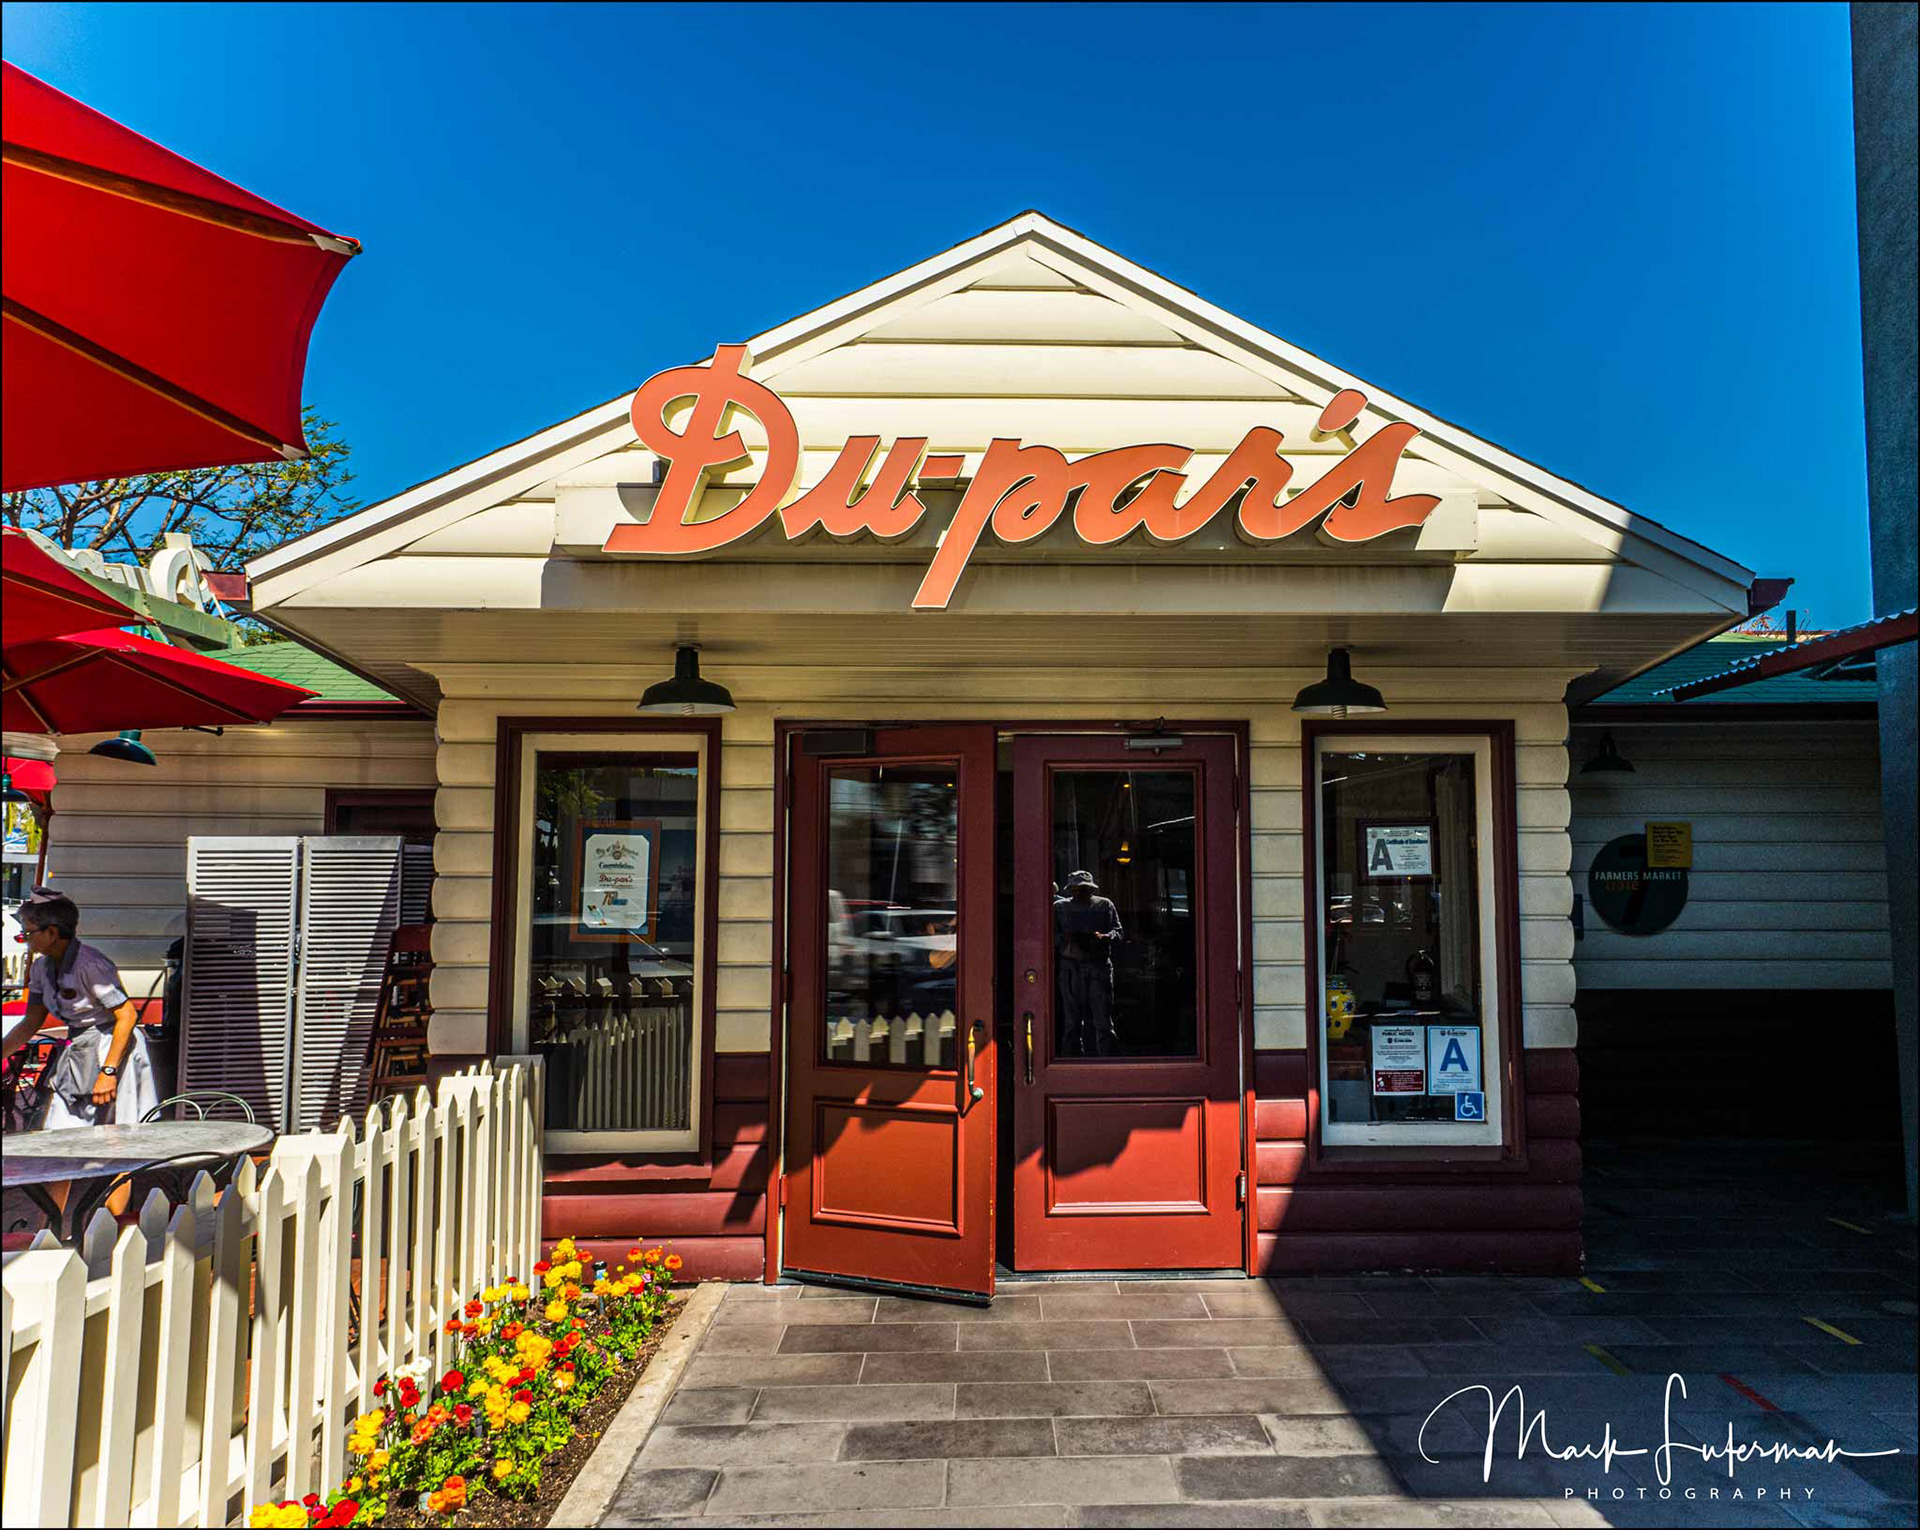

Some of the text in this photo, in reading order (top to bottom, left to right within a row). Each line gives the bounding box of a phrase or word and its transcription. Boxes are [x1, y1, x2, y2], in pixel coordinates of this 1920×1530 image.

[602, 343, 1442, 610] Du-par's
[1370, 838, 1394, 871] A
[1595, 870, 1682, 881] FARMERS MARKET
[1440, 1038, 1469, 1071] A
